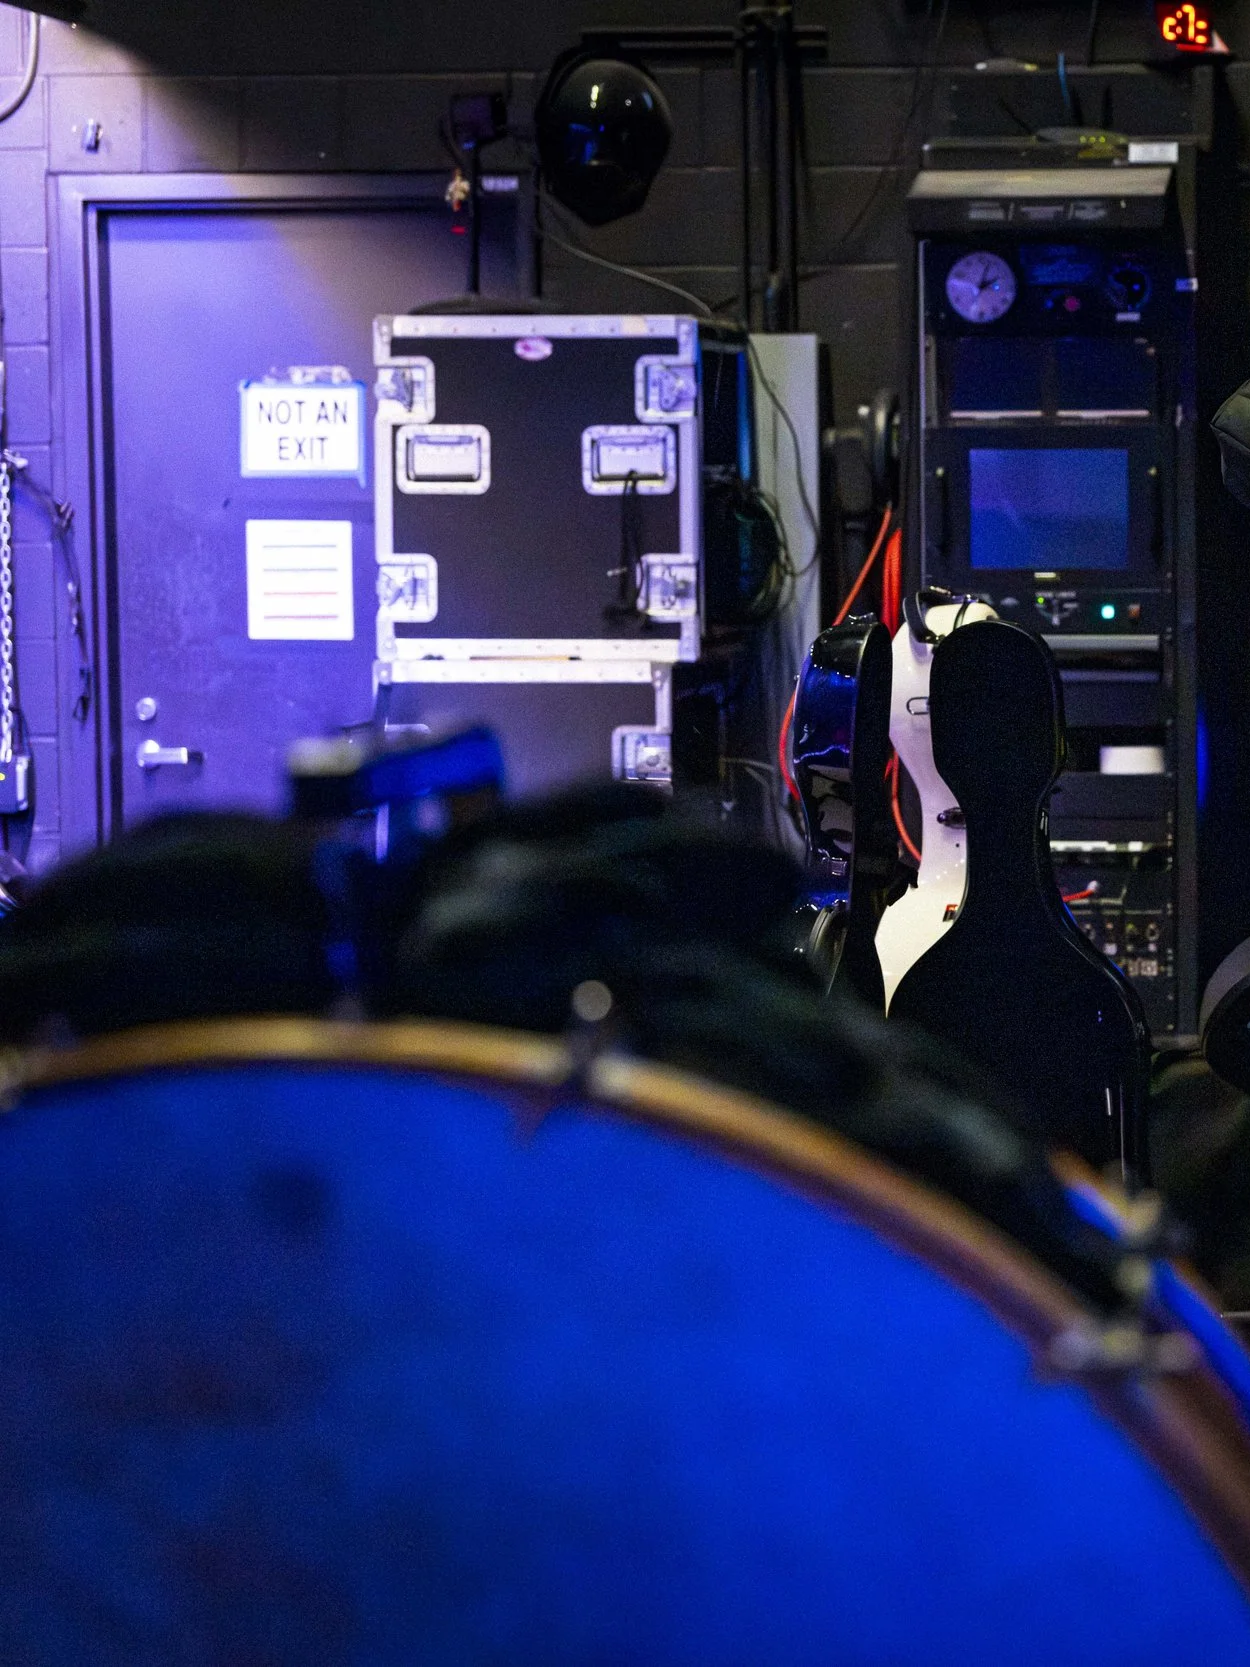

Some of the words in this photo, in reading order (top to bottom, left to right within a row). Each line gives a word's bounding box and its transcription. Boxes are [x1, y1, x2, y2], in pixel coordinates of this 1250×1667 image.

[258, 400, 305, 425] NOT
[316, 400, 348, 425] AN
[278, 436, 328, 461] EXIT
